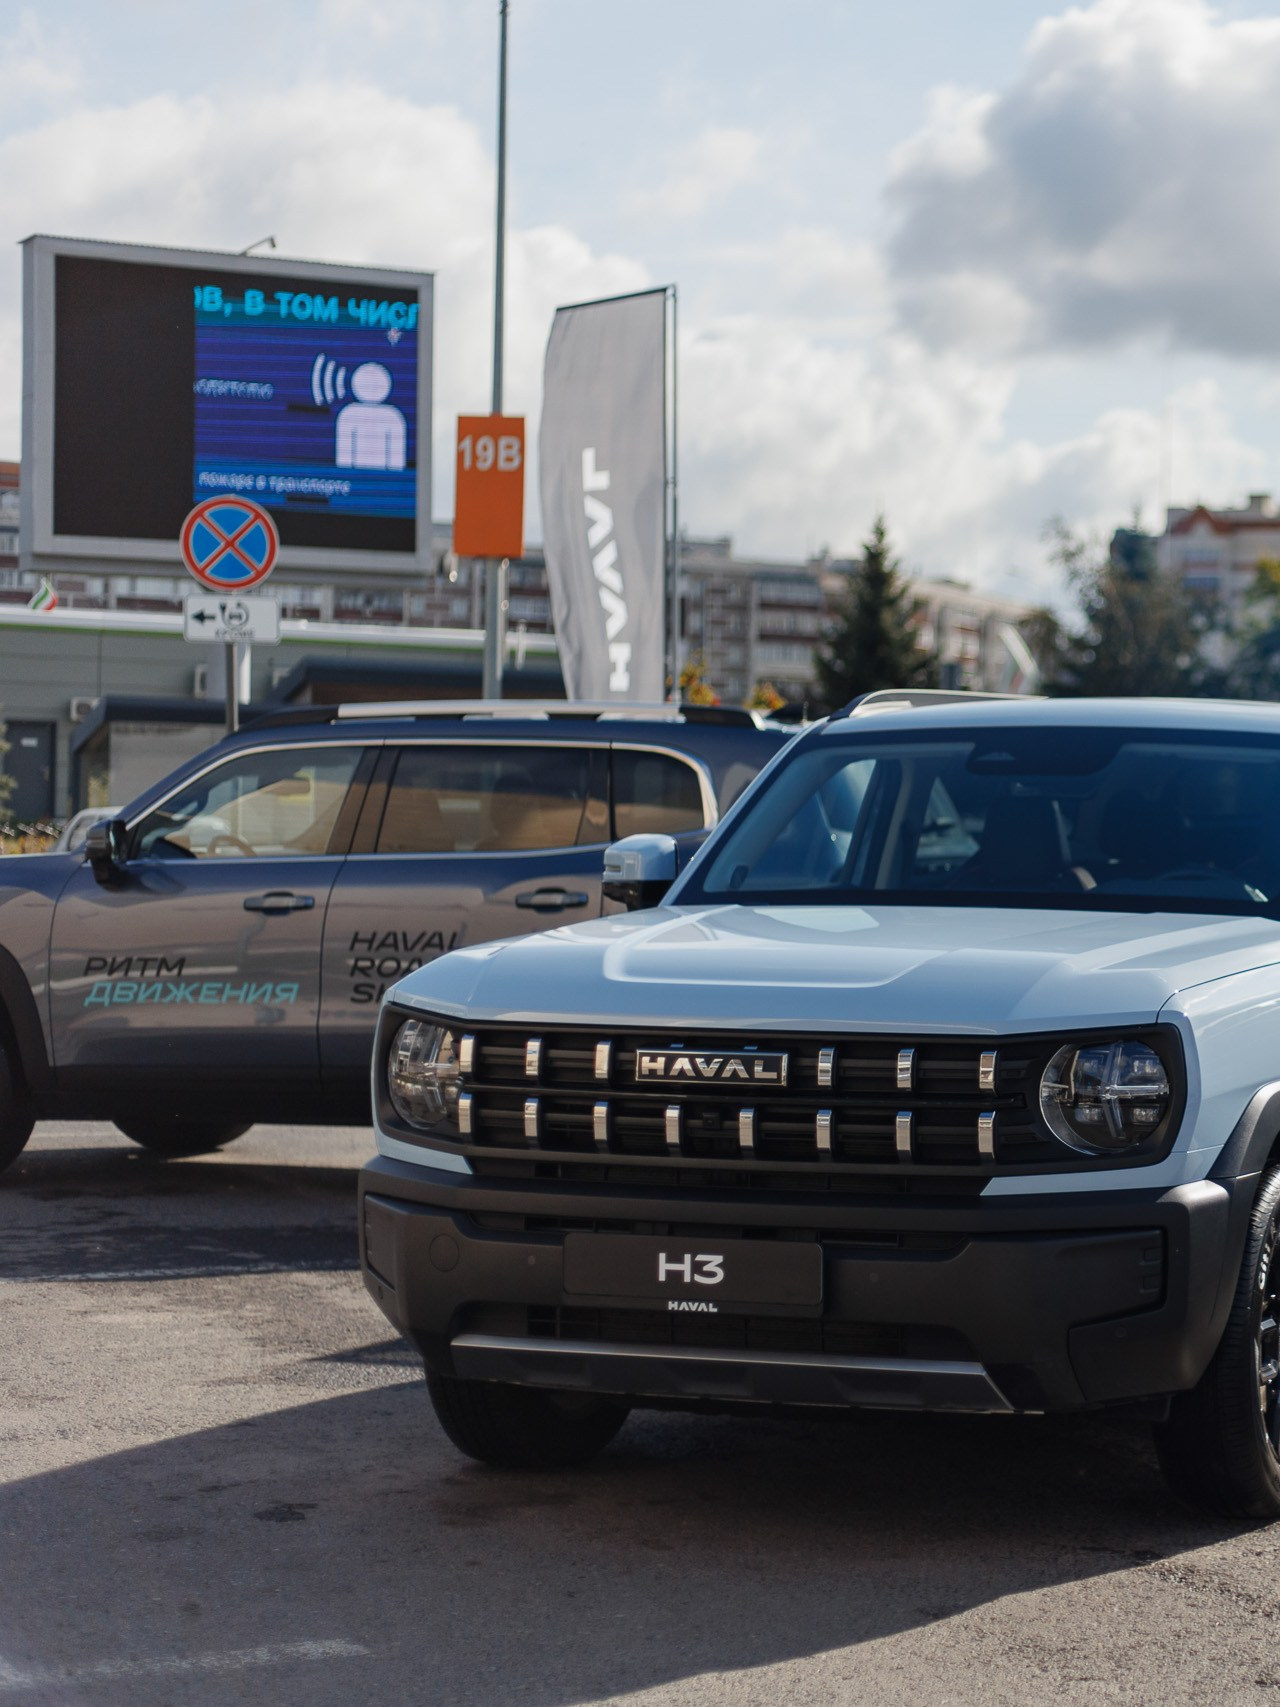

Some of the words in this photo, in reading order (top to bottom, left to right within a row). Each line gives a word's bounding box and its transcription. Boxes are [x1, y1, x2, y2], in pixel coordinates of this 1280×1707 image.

[244, 289, 265, 316] В
[274, 291, 339, 323] ТОМ
[348, 930, 460, 953] HAVAL
[84, 956, 186, 978] РИТМ
[349, 957, 424, 979] ROA
[83, 981, 300, 1008] ДВИЖЕНИЯ
[640, 1055, 778, 1080] HAVAL
[658, 1252, 725, 1285] H3
[667, 1300, 718, 1313] HAVAL
